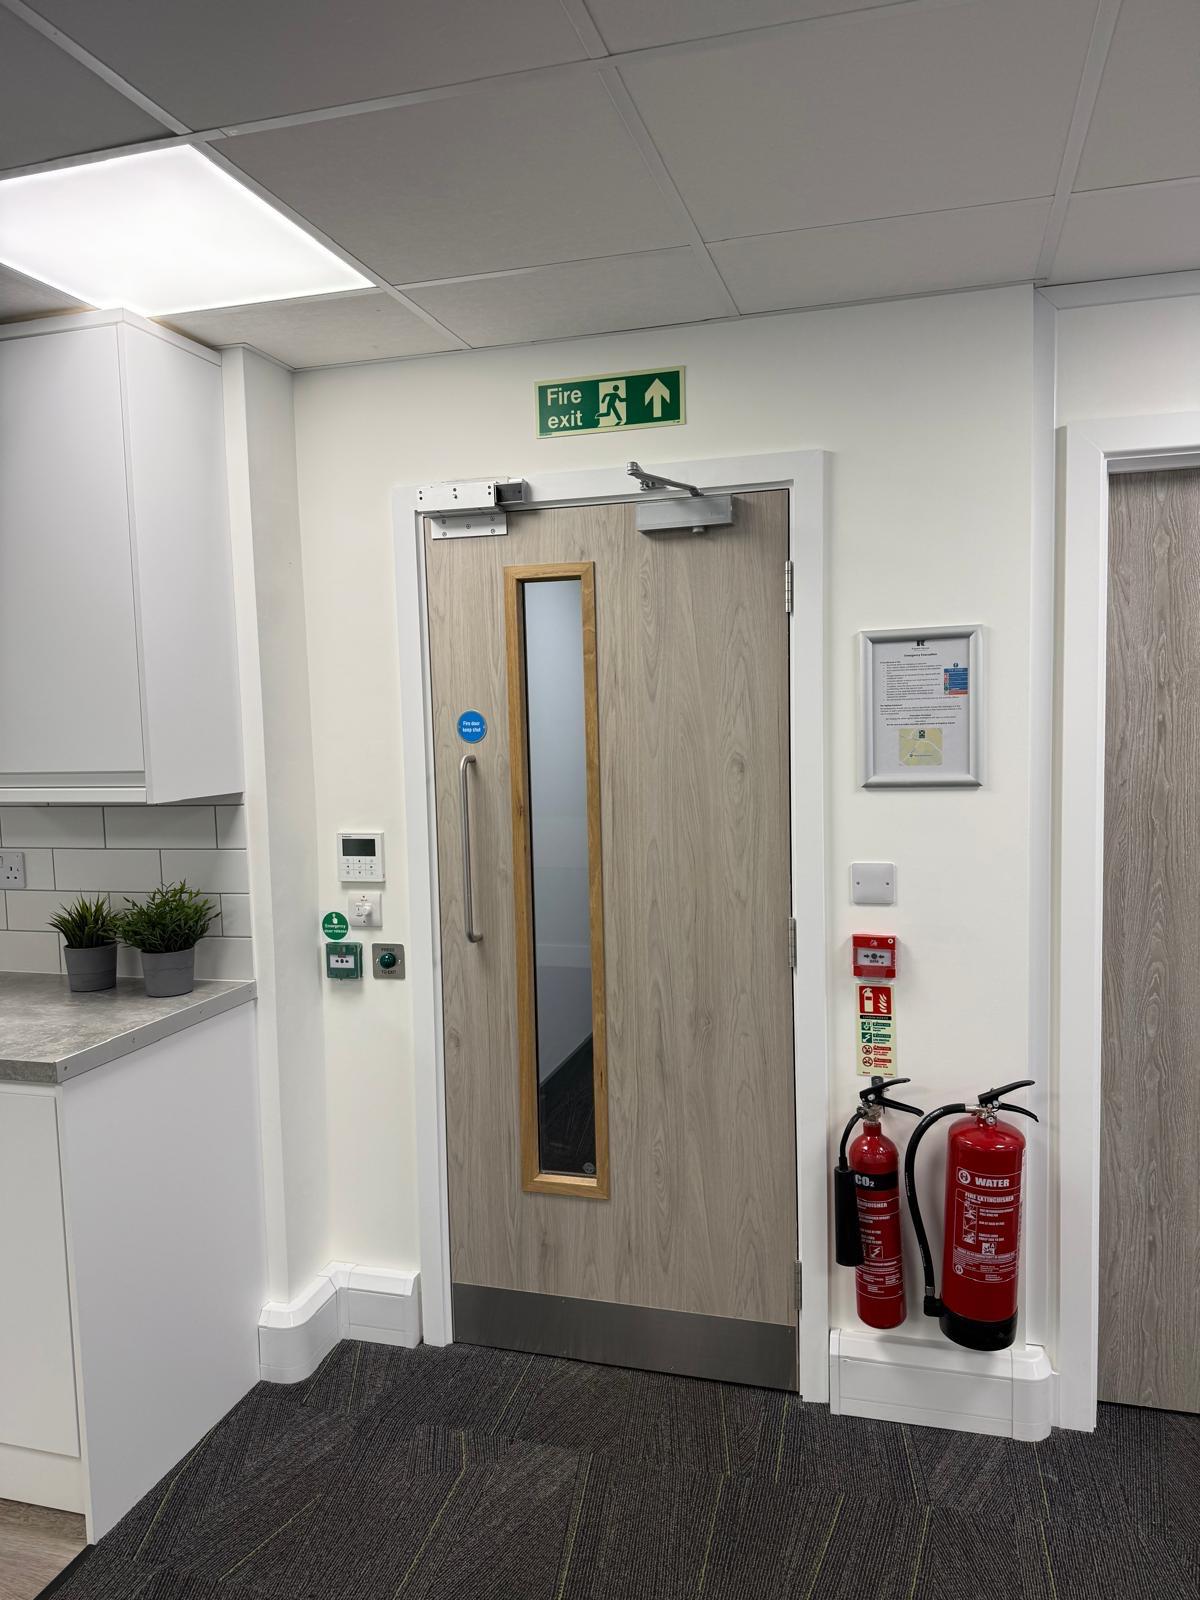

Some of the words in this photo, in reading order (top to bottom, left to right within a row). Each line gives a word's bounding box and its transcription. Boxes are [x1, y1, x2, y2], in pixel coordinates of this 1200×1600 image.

[547, 387, 582, 406] Fire
[547, 410, 583, 429] exit
[975, 1177, 1010, 1188] WATER
[965, 1191, 976, 1200] FIRE
[977, 1194, 1014, 1203] EXTINGUISHER
